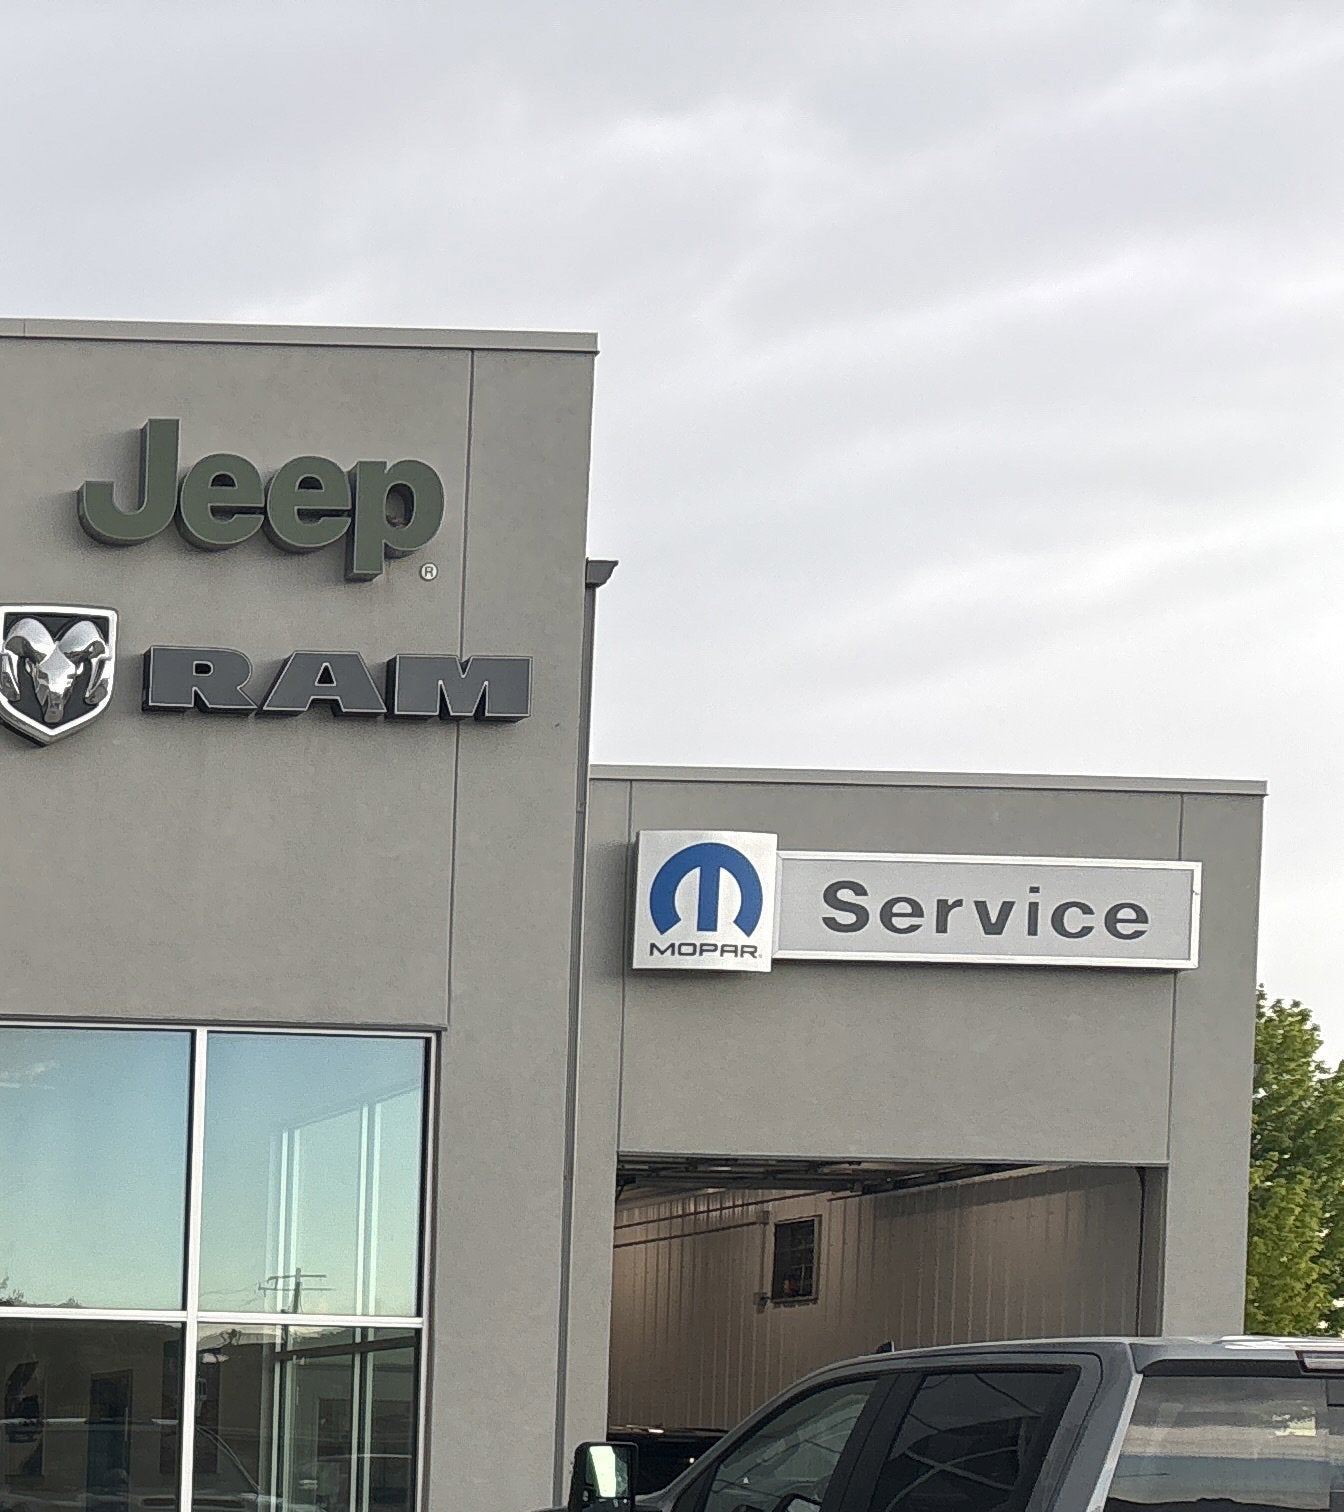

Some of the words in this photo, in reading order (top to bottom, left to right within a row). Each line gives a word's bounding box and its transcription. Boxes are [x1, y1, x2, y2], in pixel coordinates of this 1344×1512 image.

[76, 417, 446, 582] Jeep
[142, 644, 534, 723] RAM
[821, 879, 1150, 941] Service
[648, 942, 759, 959] MOPAR
